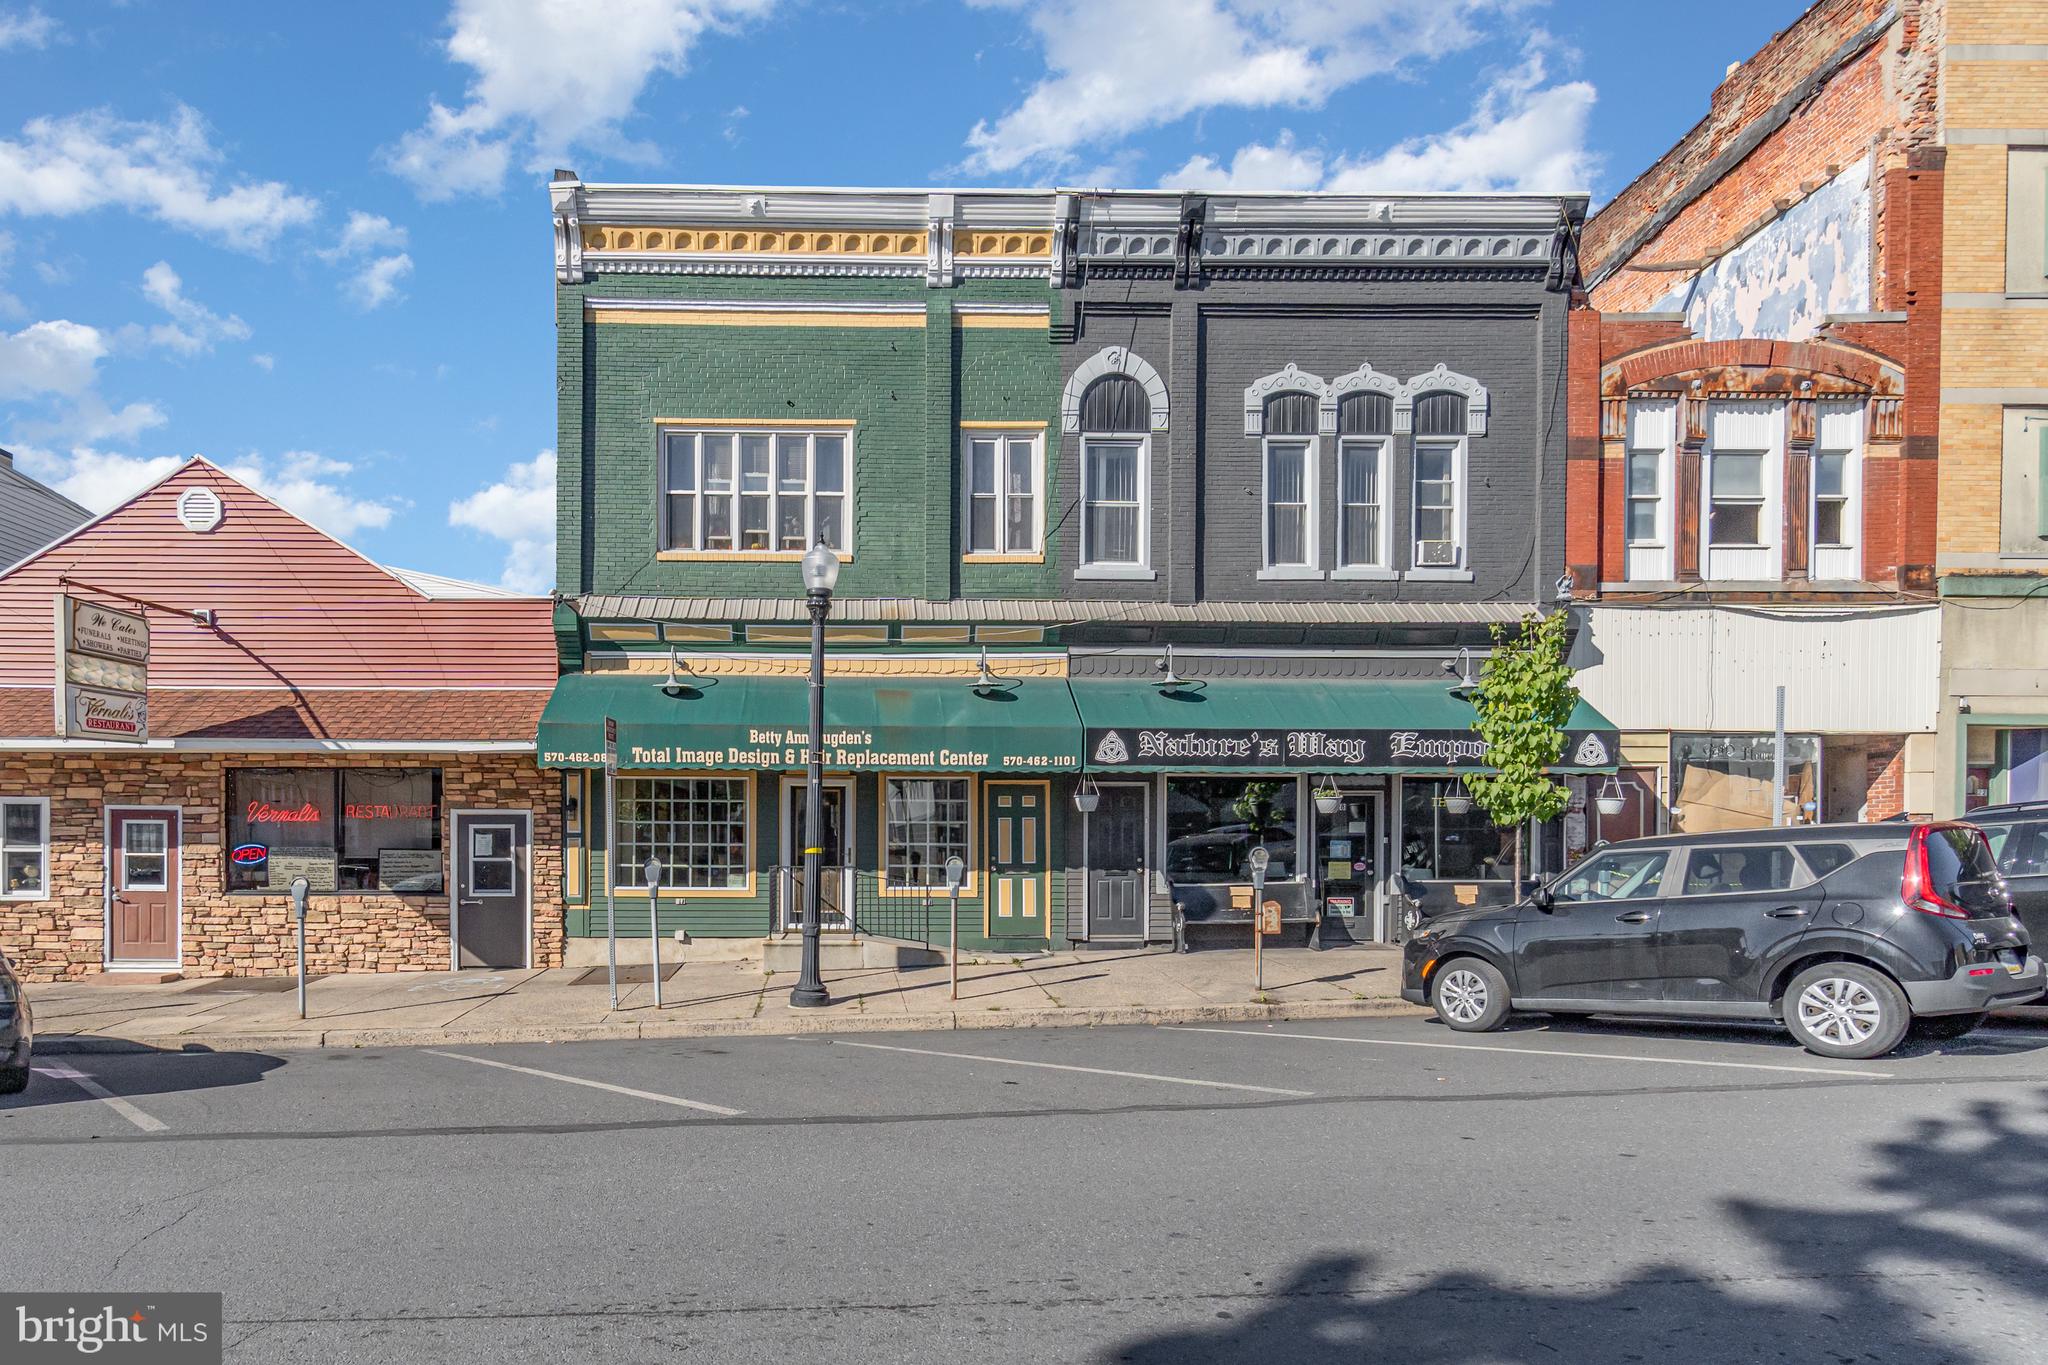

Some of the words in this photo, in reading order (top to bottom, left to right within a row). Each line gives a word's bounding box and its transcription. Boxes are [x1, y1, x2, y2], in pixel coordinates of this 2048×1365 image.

[91, 612, 106, 627] We
[111, 617, 137, 635] Cater
[80, 626, 111, 641] FUNERALS
[120, 635, 147, 649] MEETINGS
[86, 639, 113, 652] SHOWERS
[120, 647, 142, 658] PARTIES
[87, 718, 135, 732] RESTAURANT
[749, 729, 783, 747] Betty
[785, 729, 810, 745] Ann
[822, 730, 872, 748] ugden's
[1138, 730, 1280, 758] Nature's
[1286, 731, 1367, 763] Way
[631, 746, 671, 764] Total
[675, 746, 724, 767] Image
[728, 746, 780, 768] Design
[784, 748, 796, 765] &
[836, 749, 935, 768] Replacement
[939, 749, 989, 767] Center
[1003, 755, 1076, 766] 570-462-1101
[247, 800, 321, 823] Vernalis
[345, 804, 437, 819] RESTAURANT
[231, 848, 267, 862] OPEN
